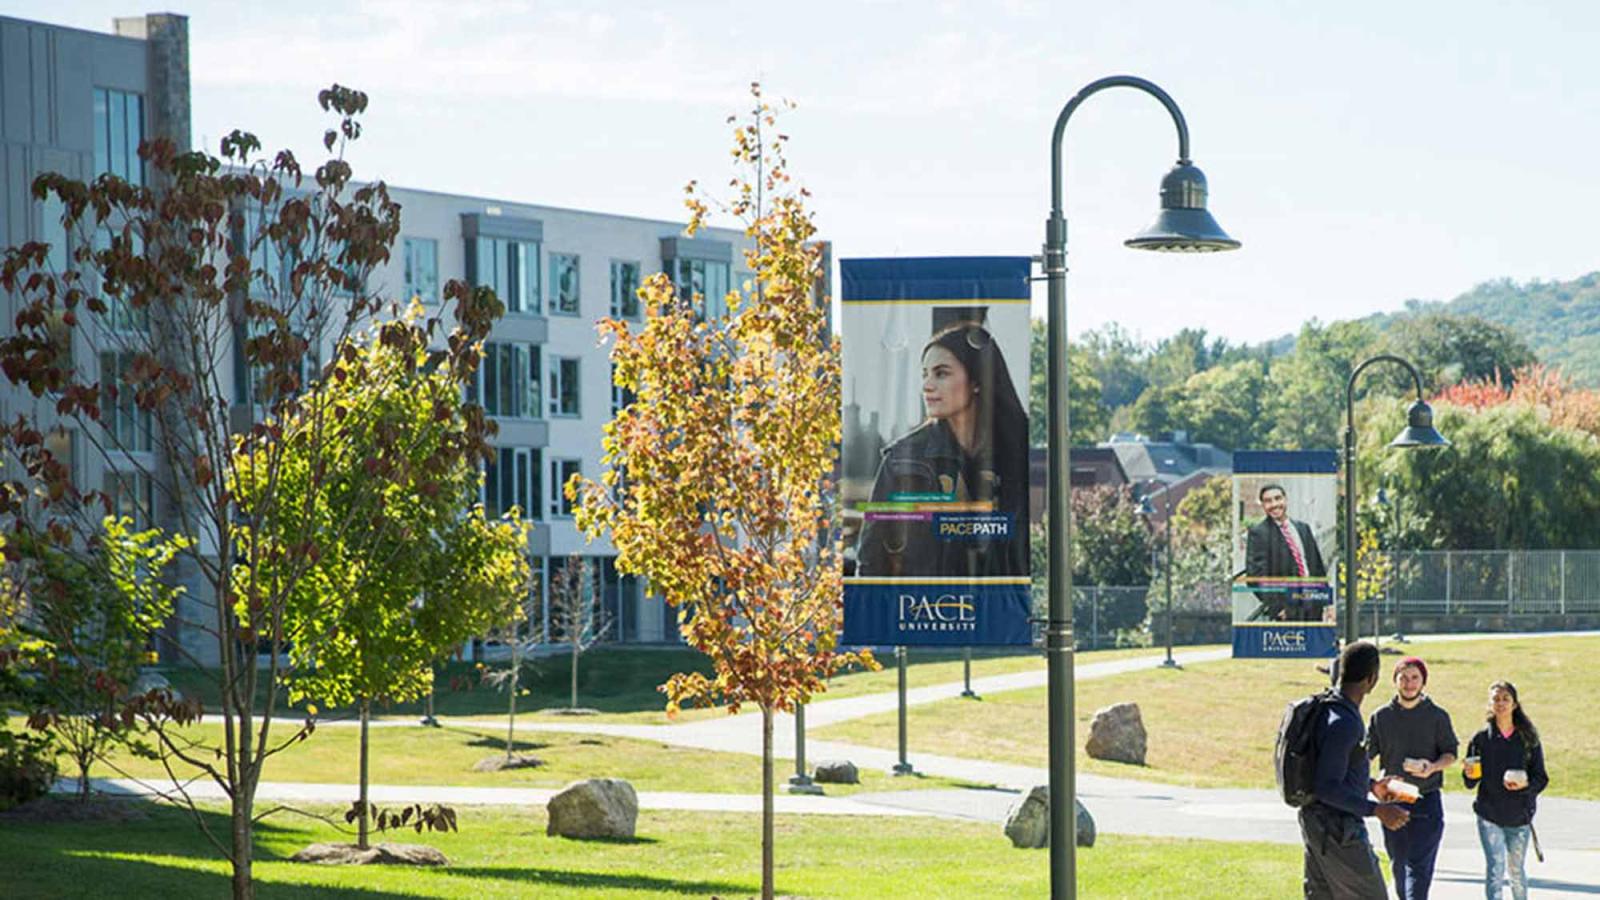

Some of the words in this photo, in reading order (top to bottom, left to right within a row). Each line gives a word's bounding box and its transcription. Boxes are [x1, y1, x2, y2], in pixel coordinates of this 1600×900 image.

[940, 523, 1008, 535] PACEPATH
[899, 595, 976, 621] PACE
[899, 622, 976, 631] UNIVERSITY
[1263, 630, 1305, 646] PACE
